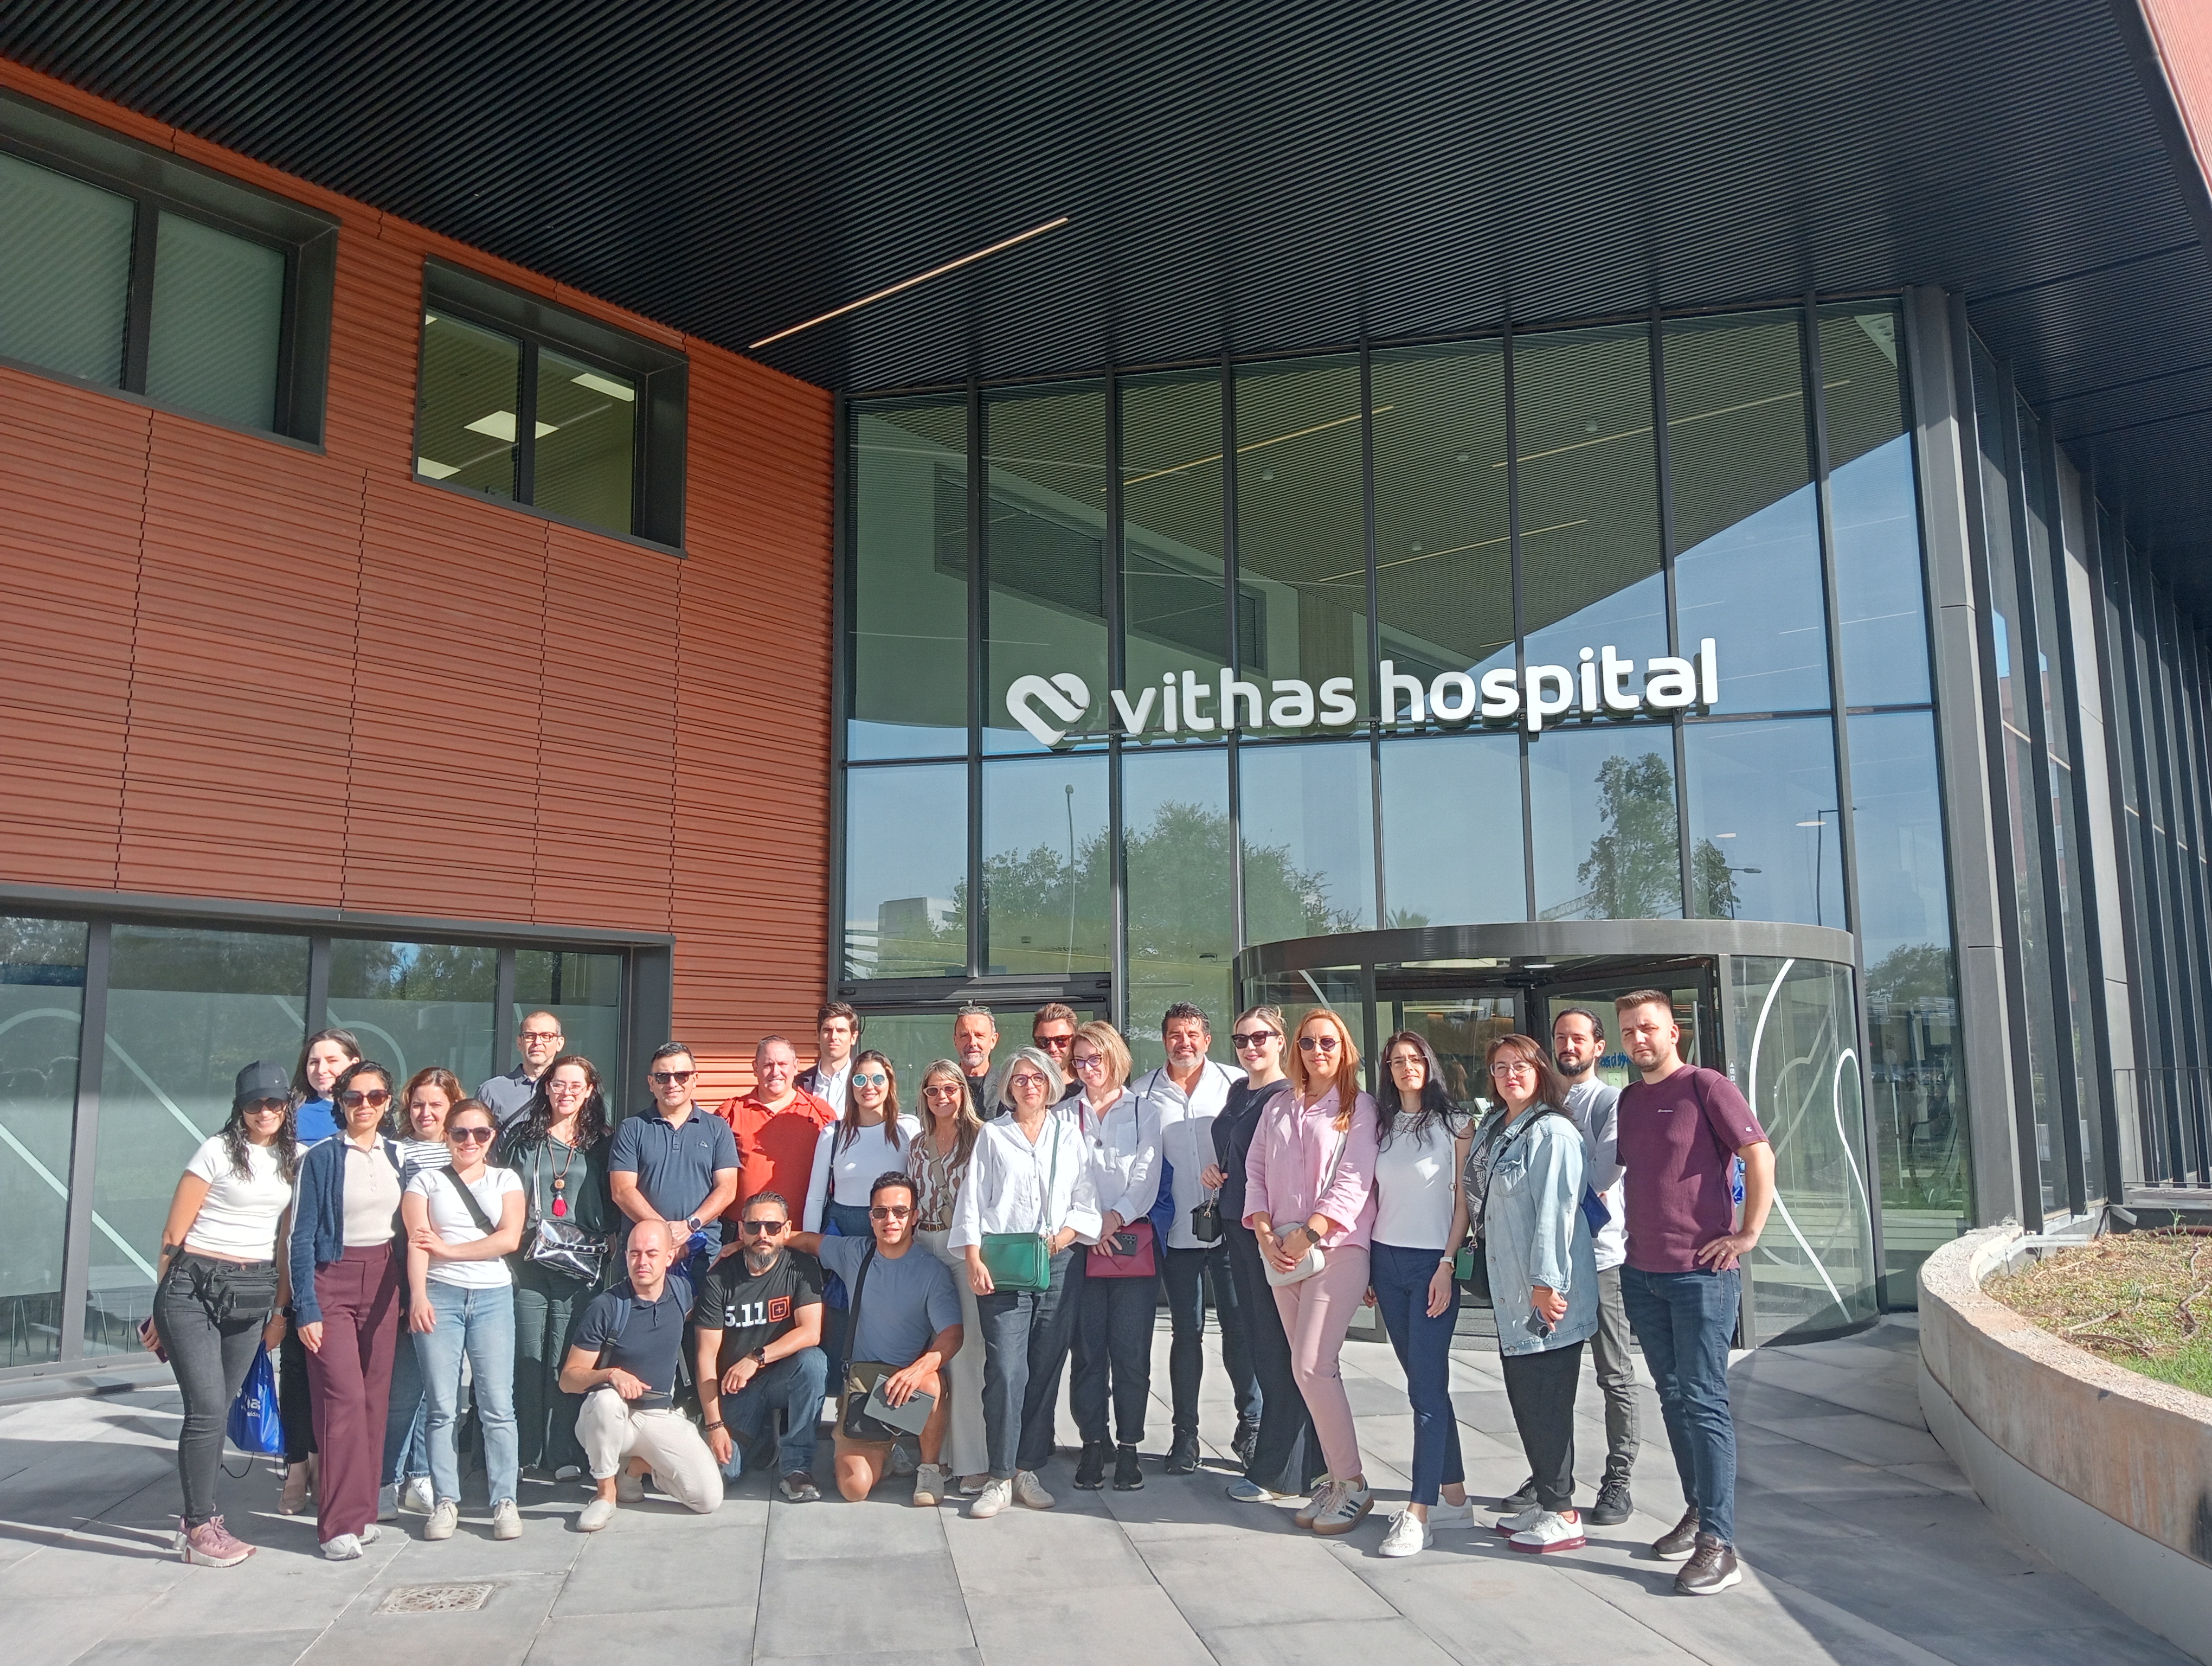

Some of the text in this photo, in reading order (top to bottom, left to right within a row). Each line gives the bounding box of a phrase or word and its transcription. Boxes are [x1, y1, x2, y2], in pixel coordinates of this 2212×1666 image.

[1110, 638, 1718, 734] vithas hospital
[724, 1302, 767, 1327] 5.11
